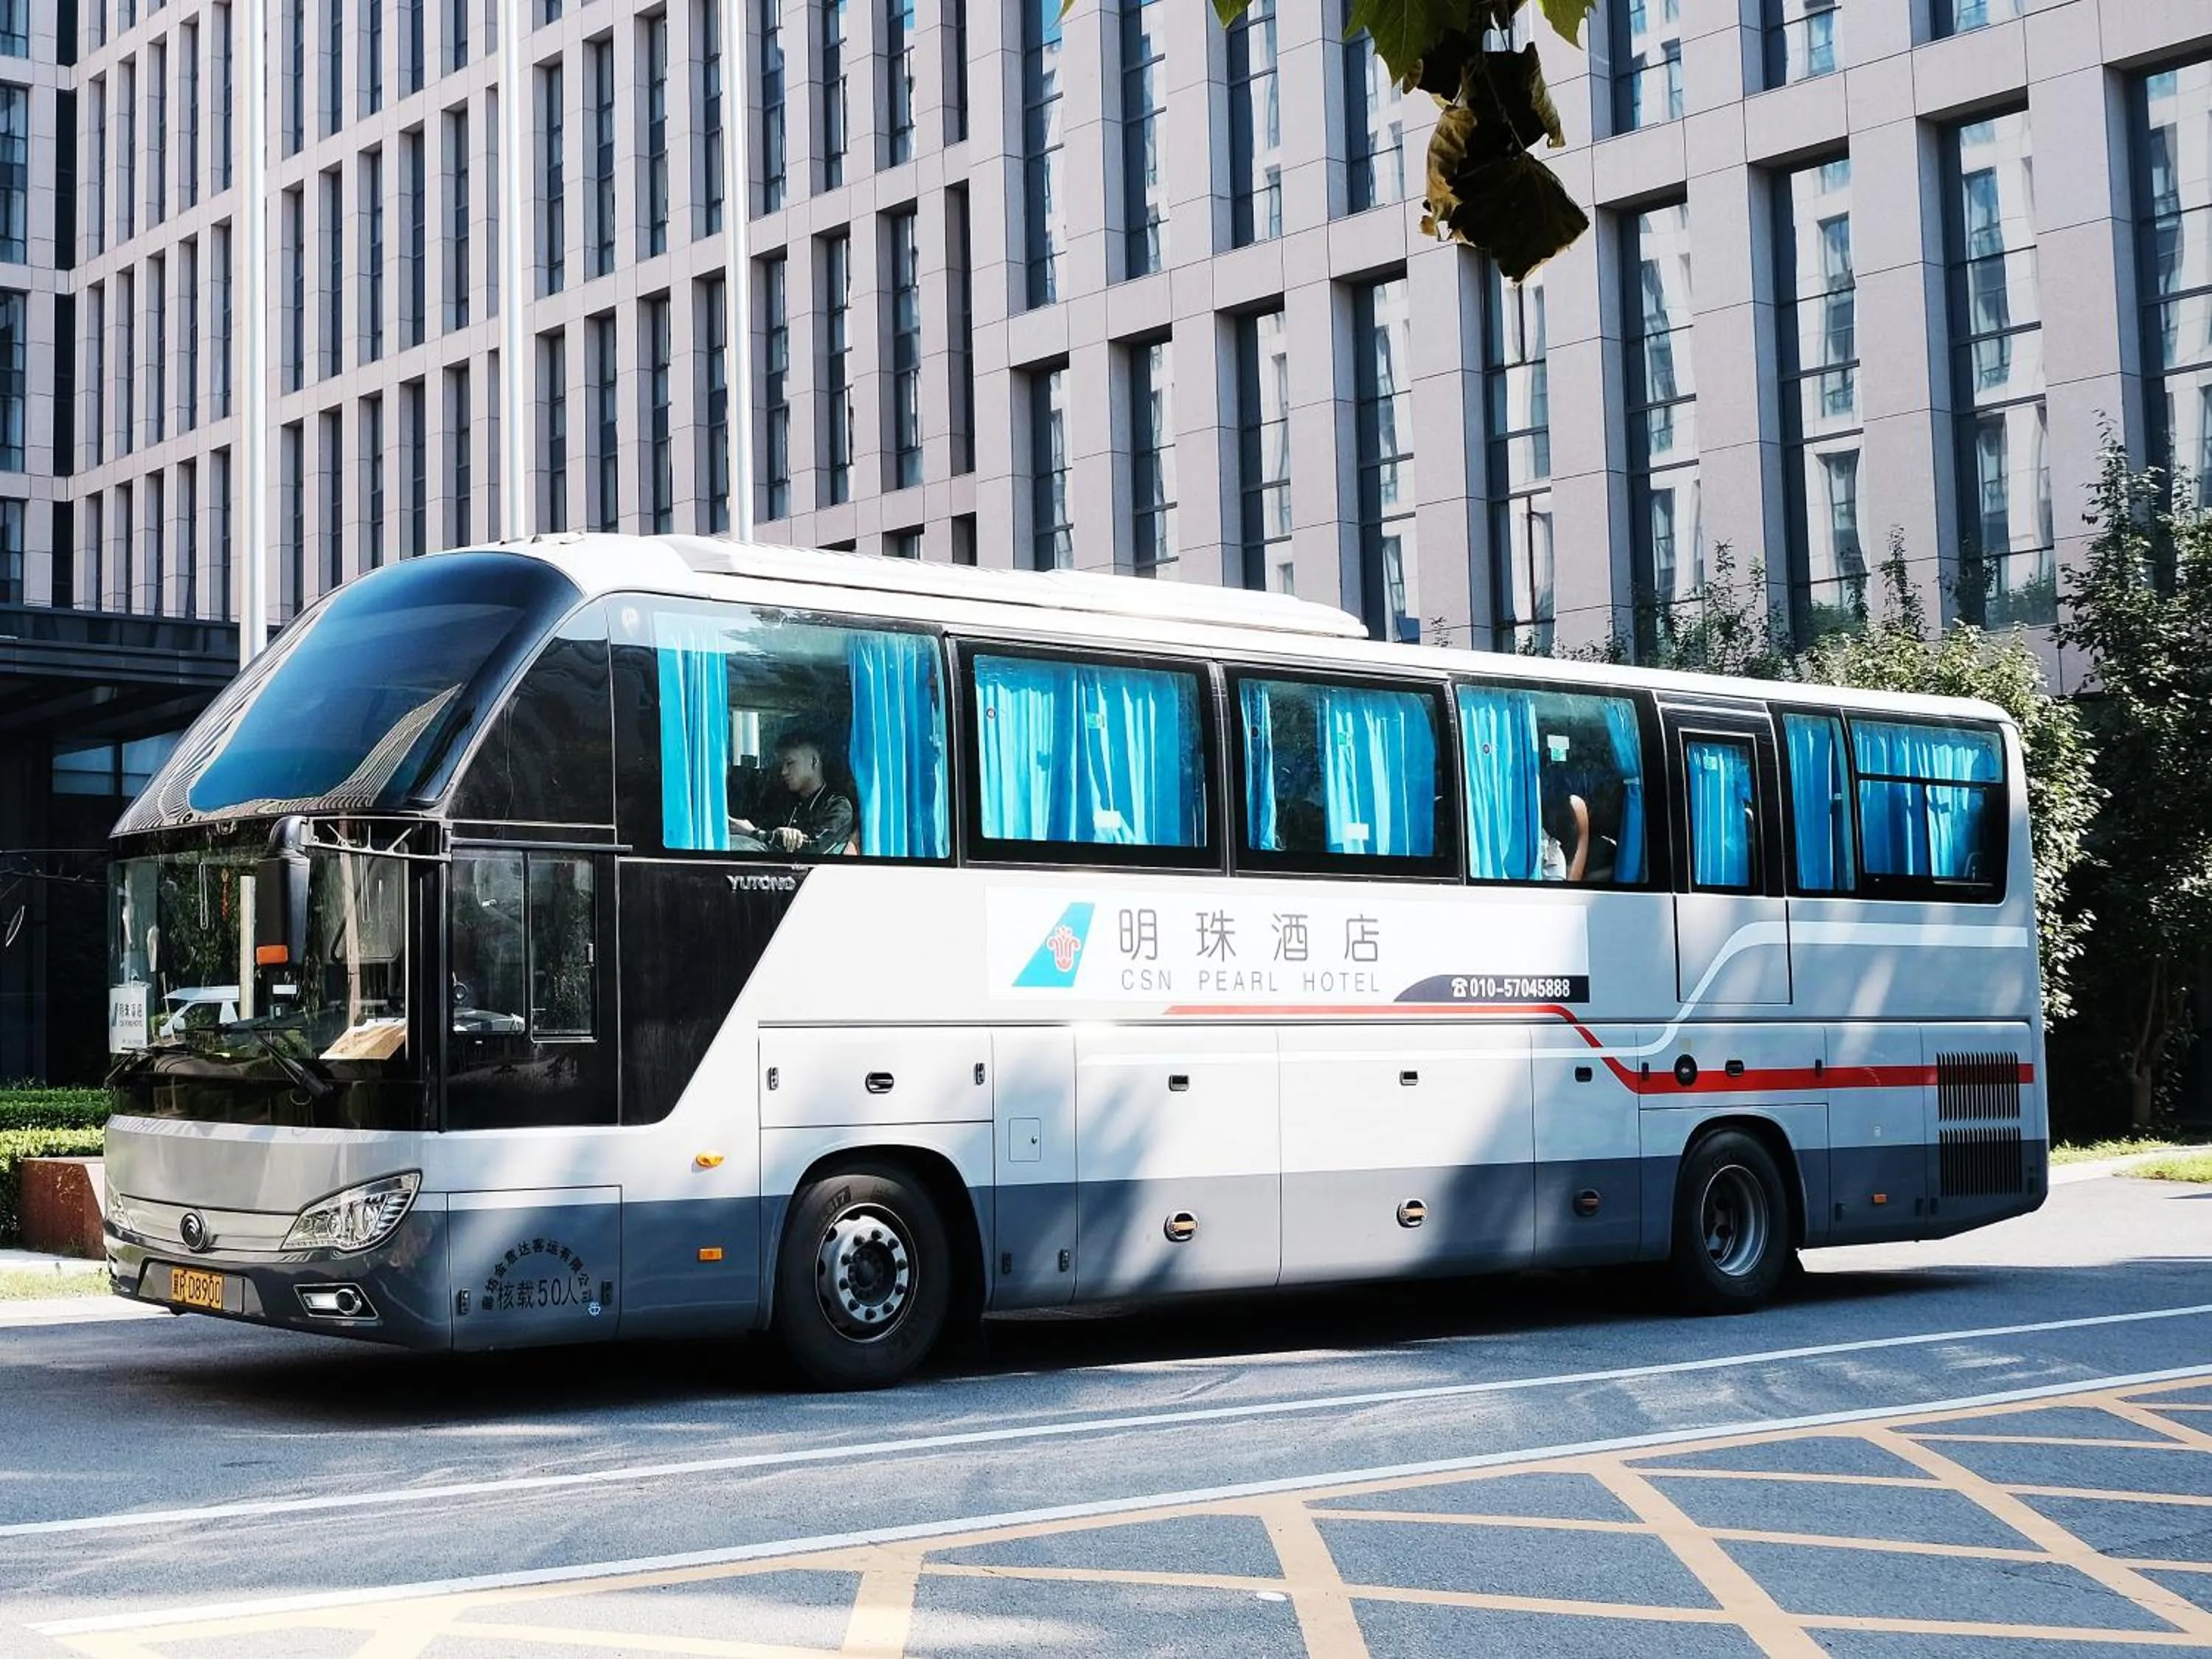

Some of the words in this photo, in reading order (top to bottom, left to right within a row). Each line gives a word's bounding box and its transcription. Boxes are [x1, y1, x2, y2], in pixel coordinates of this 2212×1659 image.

[726, 875, 796, 891] YUTONG
[1119, 908, 1380, 963] 明珠酒店
[1121, 968, 1172, 991] CSN
[1198, 970, 1279, 992] PEARL
[1302, 970, 1380, 992] HOTEL
[1470, 978, 1571, 998] 010-57045888
[497, 1277, 579, 1312] 核载50人
